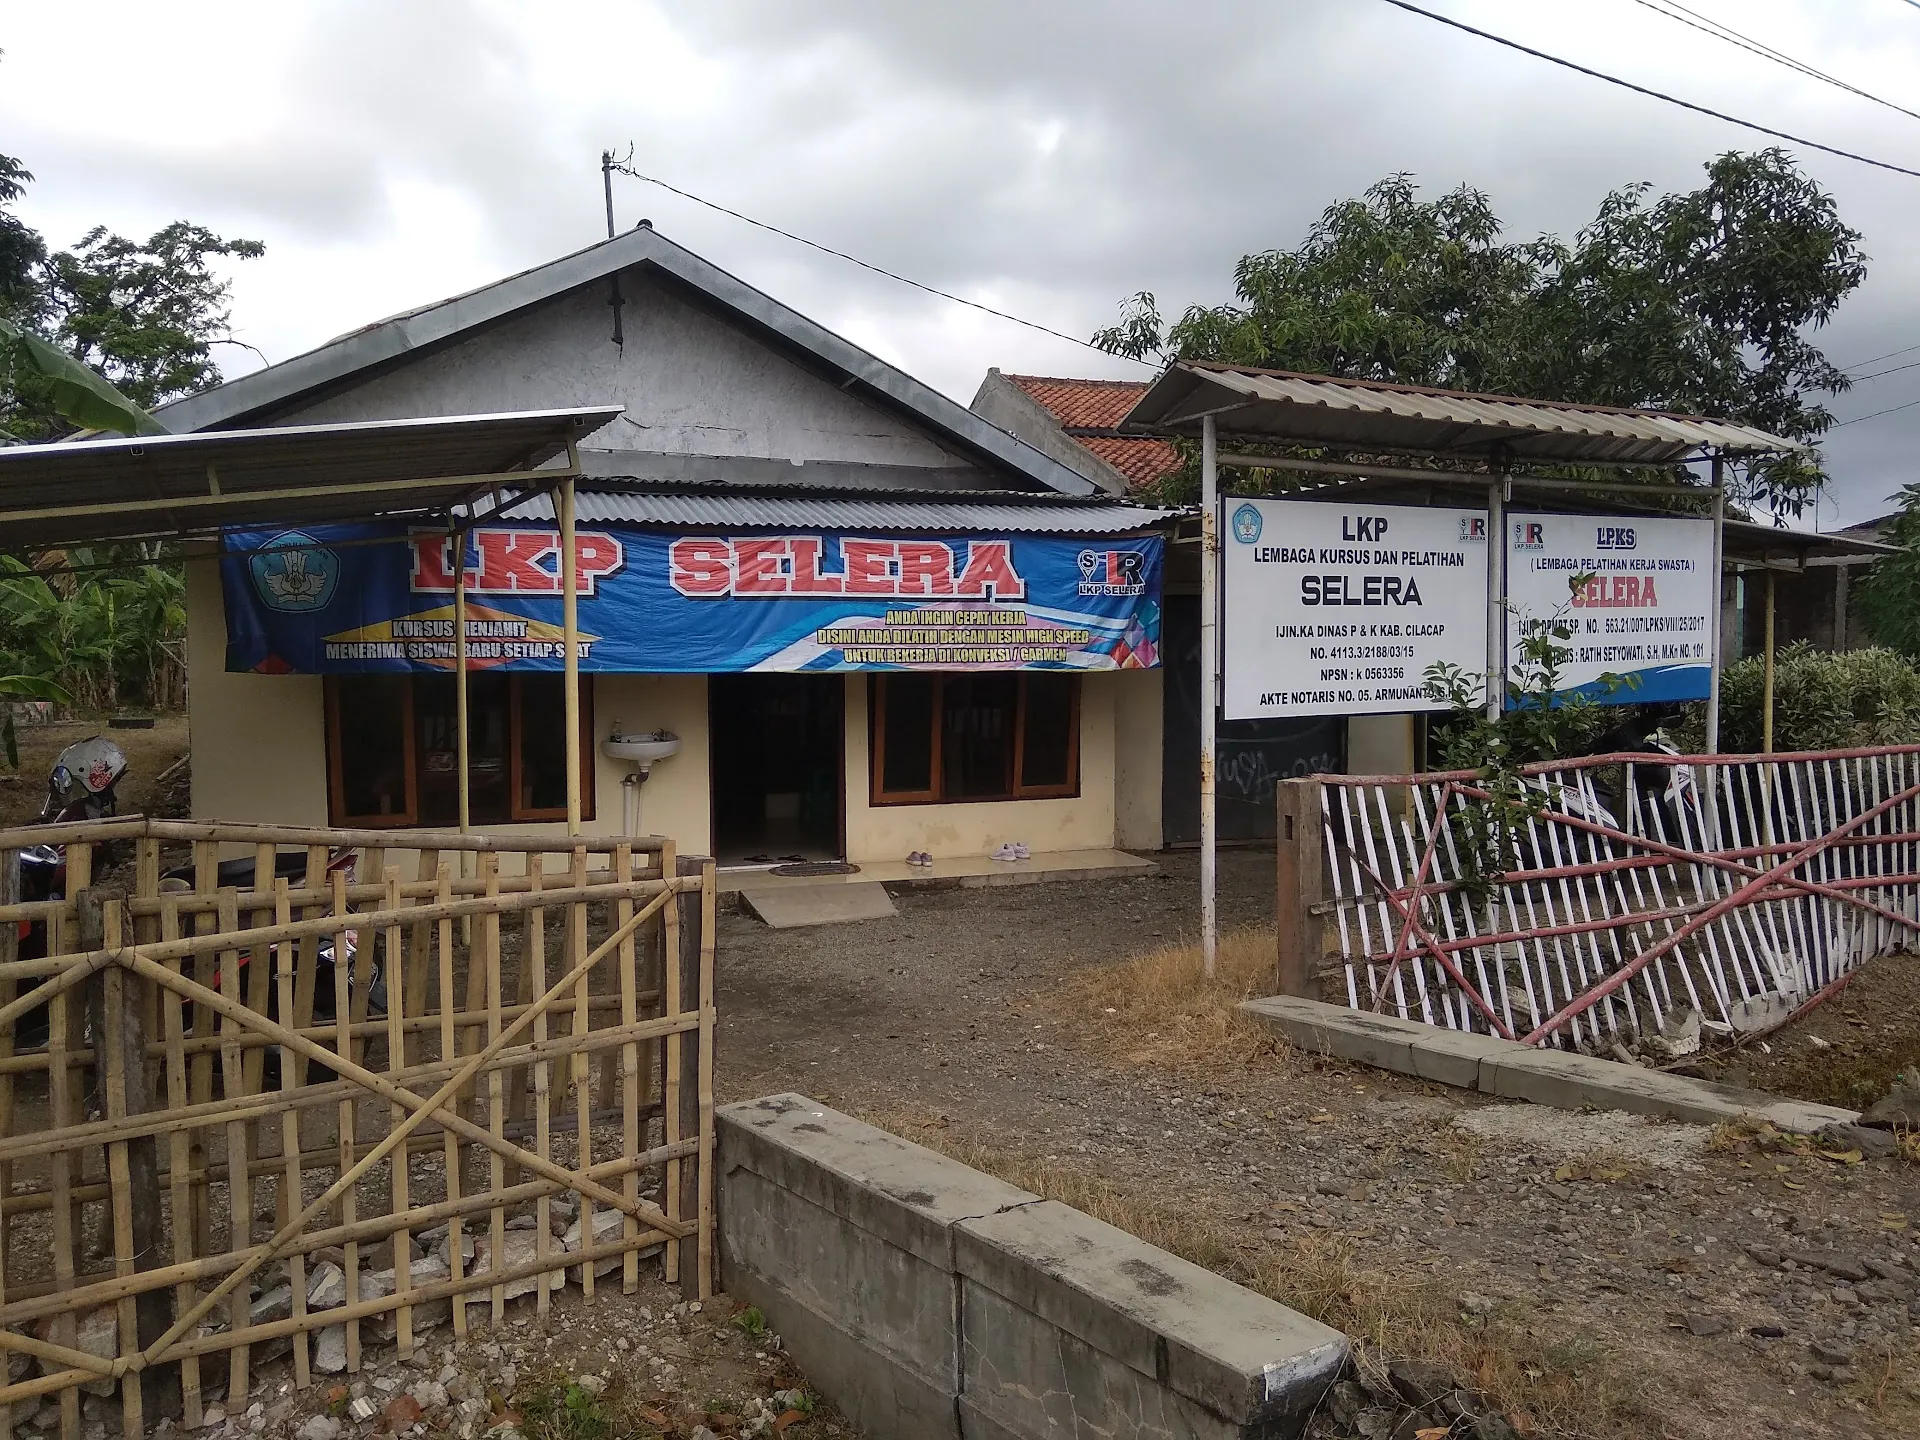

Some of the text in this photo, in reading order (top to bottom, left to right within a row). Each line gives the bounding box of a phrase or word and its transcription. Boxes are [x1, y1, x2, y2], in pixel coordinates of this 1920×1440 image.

[1342, 515, 1389, 542] LKP
[1596, 527, 1637, 548] LPKS
[408, 526, 1024, 600] LKP SELERA
[1254, 548, 1465, 567] LEMBAGA KURSUS DAN PELATIHAN
[1536, 558, 1579, 570] LEMBAGA
[1581, 558, 1628, 570] PELATIHAN
[1629, 559, 1656, 571] KERJA
[1658, 560, 1691, 571] SWASTA
[1079, 585, 1145, 595] LKP SELERA
[1301, 575, 1423, 606] SELERA
[885, 610, 1027, 625] ANDA INGIN CEPAT KERJA
[392, 620, 454, 637] KURSUS
[1275, 624, 1445, 638] IJIN.KA DINAS P & K KAB. CILACAP
[1586, 618, 1599, 634] NO.
[816, 629, 1090, 645] DISINI ANDA DILATIH DENGAN MESIN HIGH SPEED
[325, 641, 591, 659] MENERIMA SISWA BARU SETIAP SAT
[843, 648, 886, 663] UNTUK
[887, 648, 937, 663] BEKERJA
[938, 648, 951, 663] DI
[953, 647, 1010, 663] KONVEKSI
[1020, 647, 1067, 662] GARMEN
[1310, 645, 1414, 660] NO. 4113.3/2188/03/15
[1580, 646, 1601, 663] RATIH
[1603, 644, 1645, 664] SETYOWATI,
[1661, 643, 1678, 660] M.Kn
[1679, 643, 1691, 659] NO.
[1693, 642, 1704, 658] 101
[1320, 669, 1348, 681] NPSN
[1356, 668, 1363, 680] k
[1365, 667, 1404, 680] 0563356
[1259, 692, 1288, 705] AKTE
[1291, 690, 1336, 704] NOTARIS
[1338, 689, 1355, 702] NO.
[1358, 689, 1372, 702] 05.
